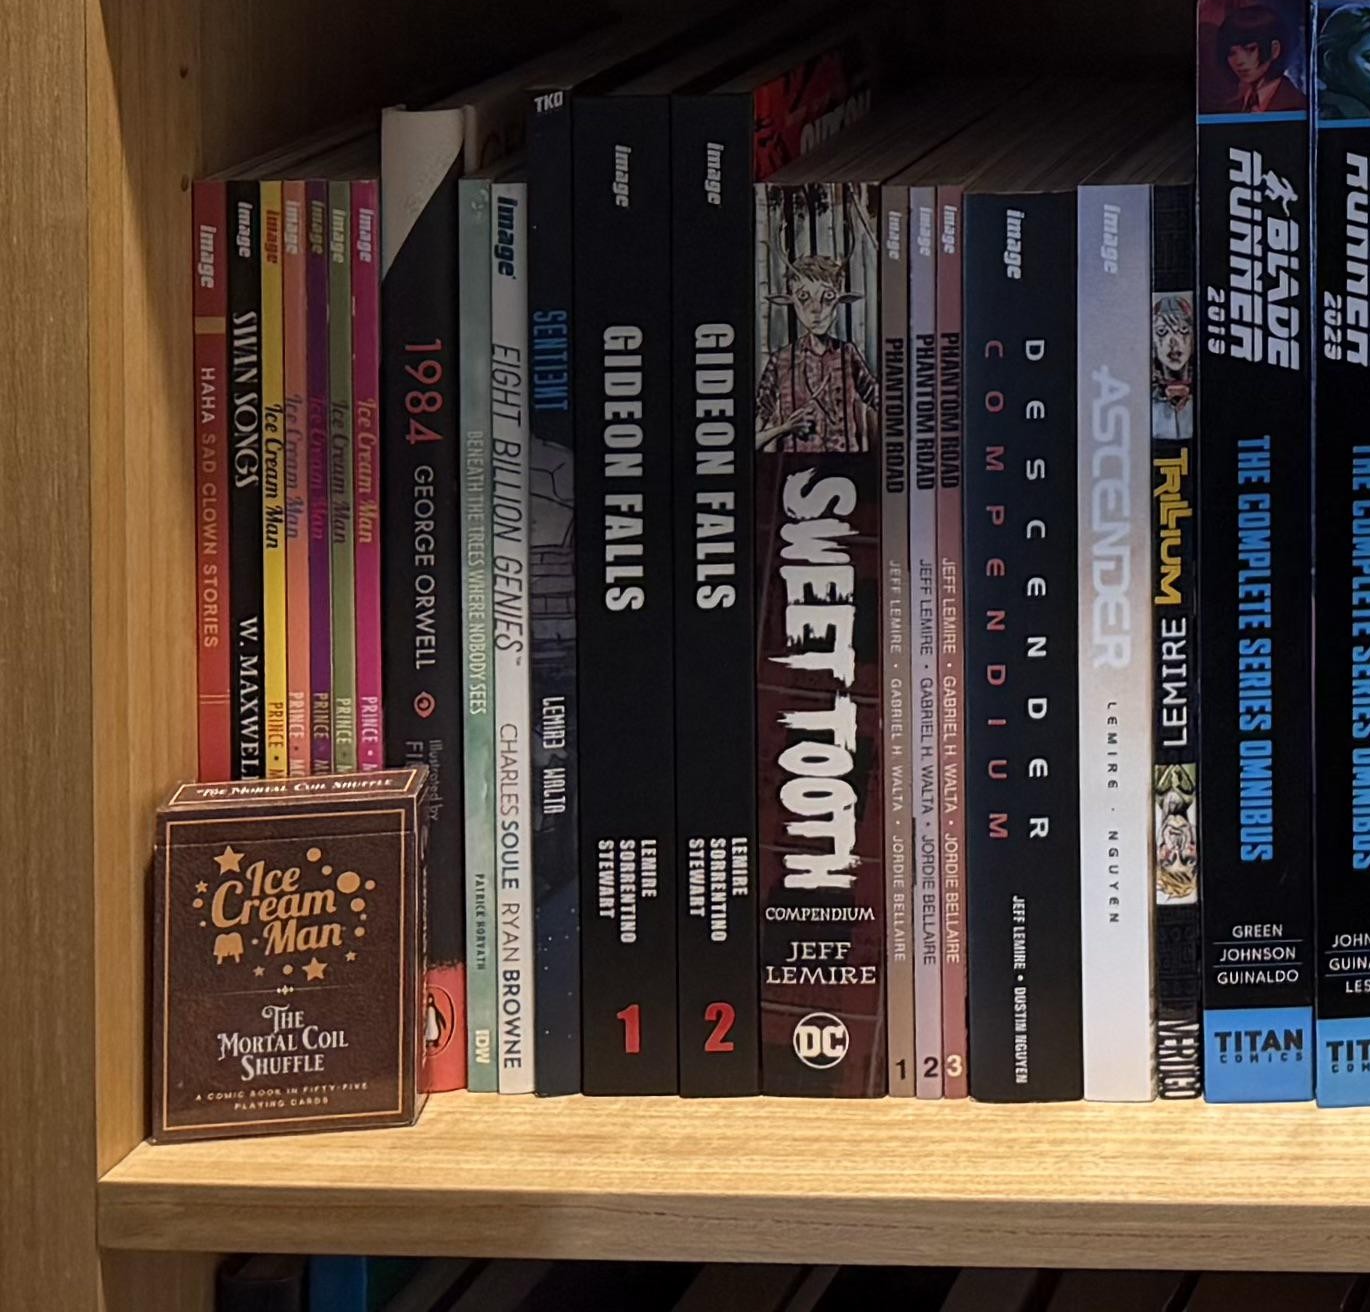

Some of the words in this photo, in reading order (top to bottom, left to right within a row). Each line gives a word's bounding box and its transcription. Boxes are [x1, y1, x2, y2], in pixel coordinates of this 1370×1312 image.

[201, 366, 216, 425] HAHA
[404, 337, 443, 446] 1984
[604, 325, 643, 479] GIDEON
[202, 434, 216, 473] SAD
[1237, 435, 1268, 485] THE
[202, 483, 216, 558] CLOWN
[415, 464, 434, 568] GEORGE
[605, 494, 645, 612] FALLS
[1238, 495, 1270, 629] COMPLETE
[203, 565, 218, 648] STORIES
[416, 575, 436, 669] ORWELL
[1239, 638, 1271, 732] SERIES
[500, 724, 519, 816] CHARLES
[1240, 740, 1273, 861] OMNIBUS
[246, 861, 301, 899] Ice
[501, 821, 519, 889] SOULE
[212, 880, 337, 928] Cream
[766, 906, 875, 922] COMPENDIUM
[263, 922, 343, 955] Man
[502, 902, 520, 964] RYAN
[787, 941, 850, 962] JEFF
[1219, 947, 1296, 962] JOHNSON
[1232, 925, 1283, 939] GREEN
[766, 966, 876, 985] LEMIRE
[1217, 970, 1299, 985] GUINALDO
[218, 1033, 297, 1061] MORTAL
[302, 1025, 348, 1050] COIL
[262, 1006, 304, 1034] THE
[503, 970, 522, 1069] BROWNE
[616, 1004, 641, 1052] 1
[704, 1001, 735, 1051] 2
[1213, 1029, 1305, 1053] TITAN
[241, 1054, 325, 1080] SHUFFLE
